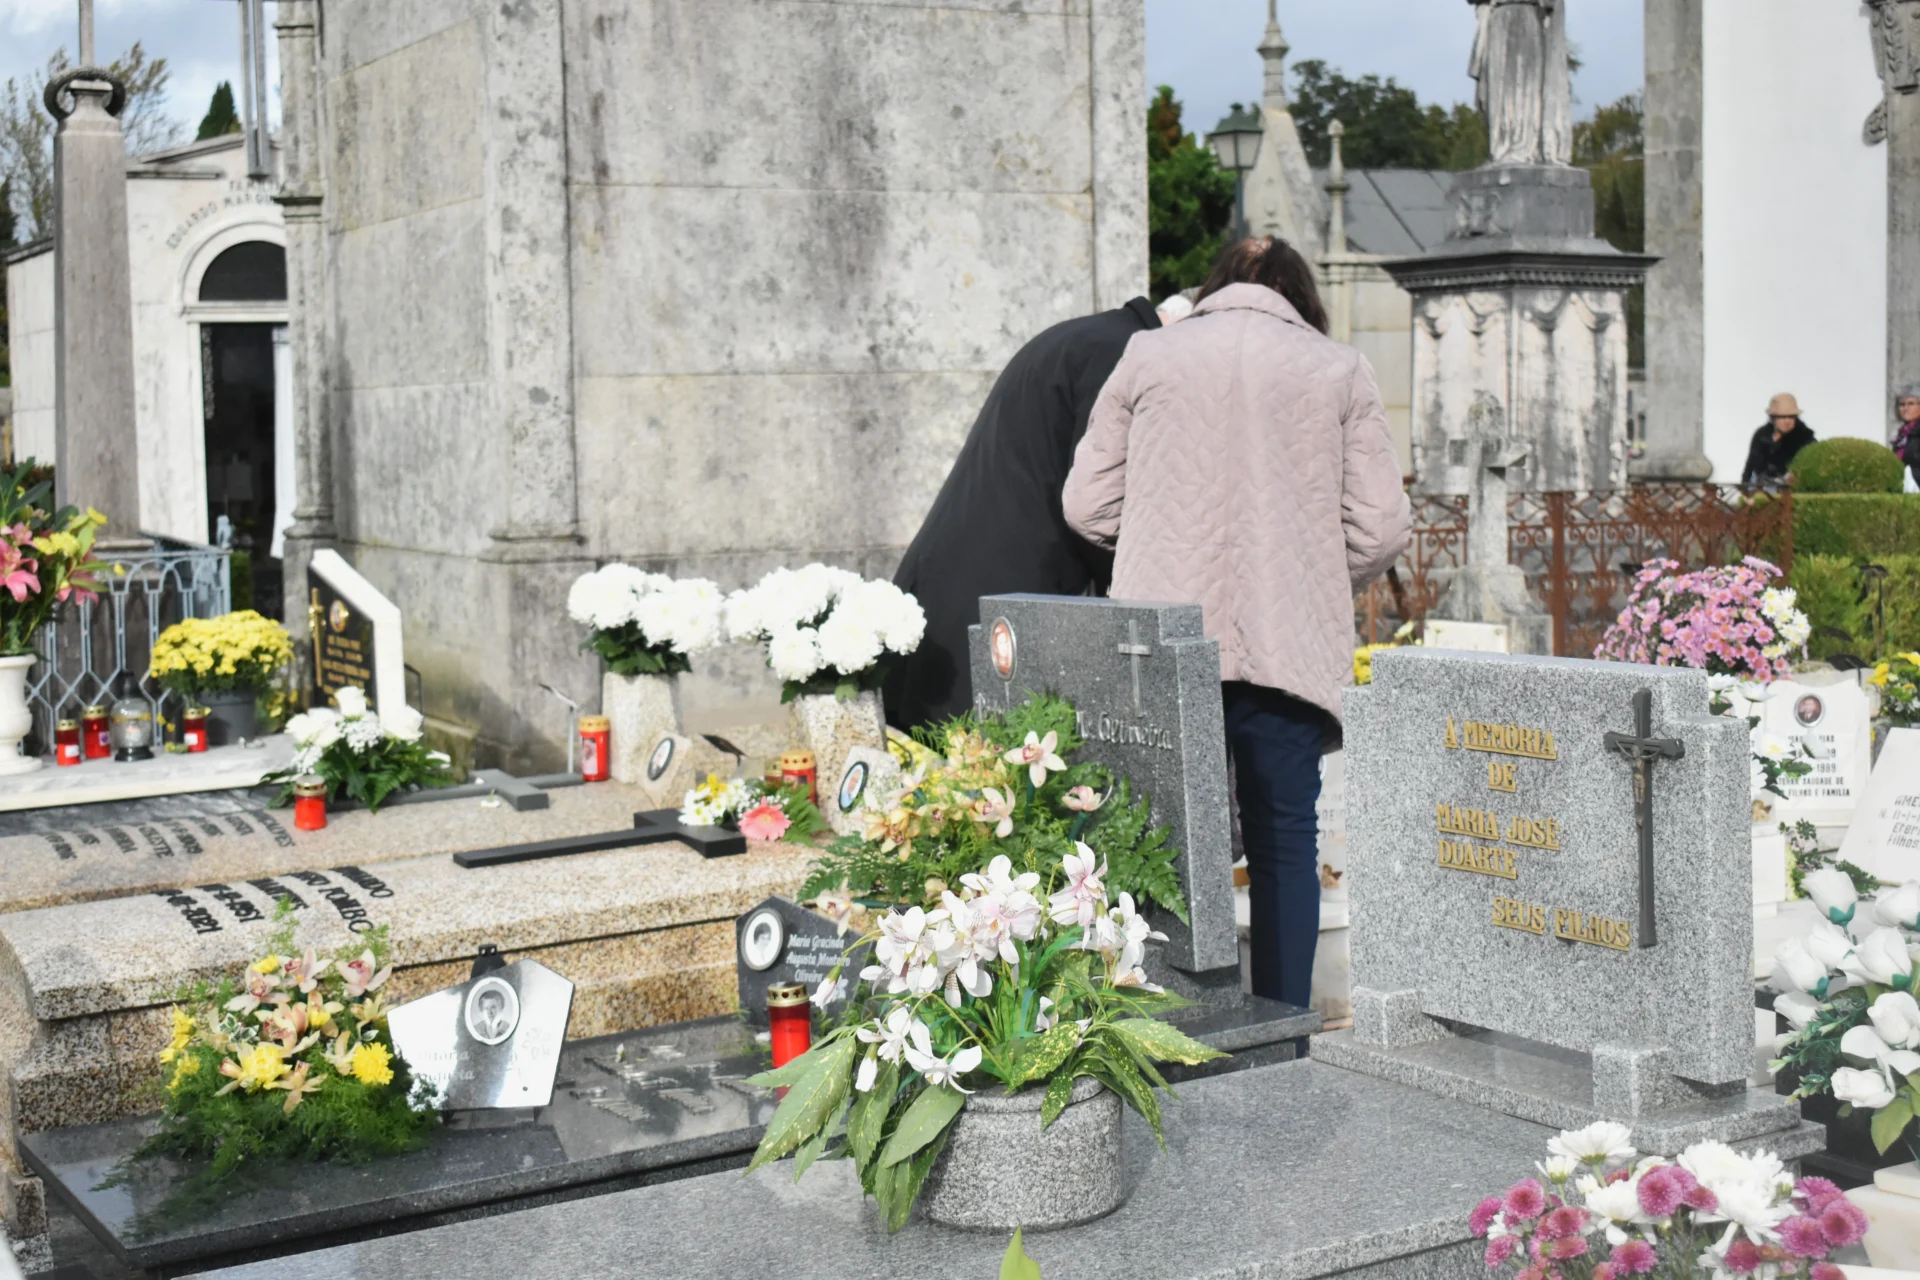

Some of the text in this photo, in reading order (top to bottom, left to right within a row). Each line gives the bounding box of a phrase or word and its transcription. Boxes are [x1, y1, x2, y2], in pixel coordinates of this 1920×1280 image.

[1488, 761, 1517, 793] DE
[1822, 788, 1850, 796] FAMILIA
[1436, 803, 1561, 851] MARIA JOSÉ
[1438, 839, 1518, 880] DUARTE
[788, 934, 810, 948] Maria
[1492, 896, 1632, 952] SEUS FILHOS
